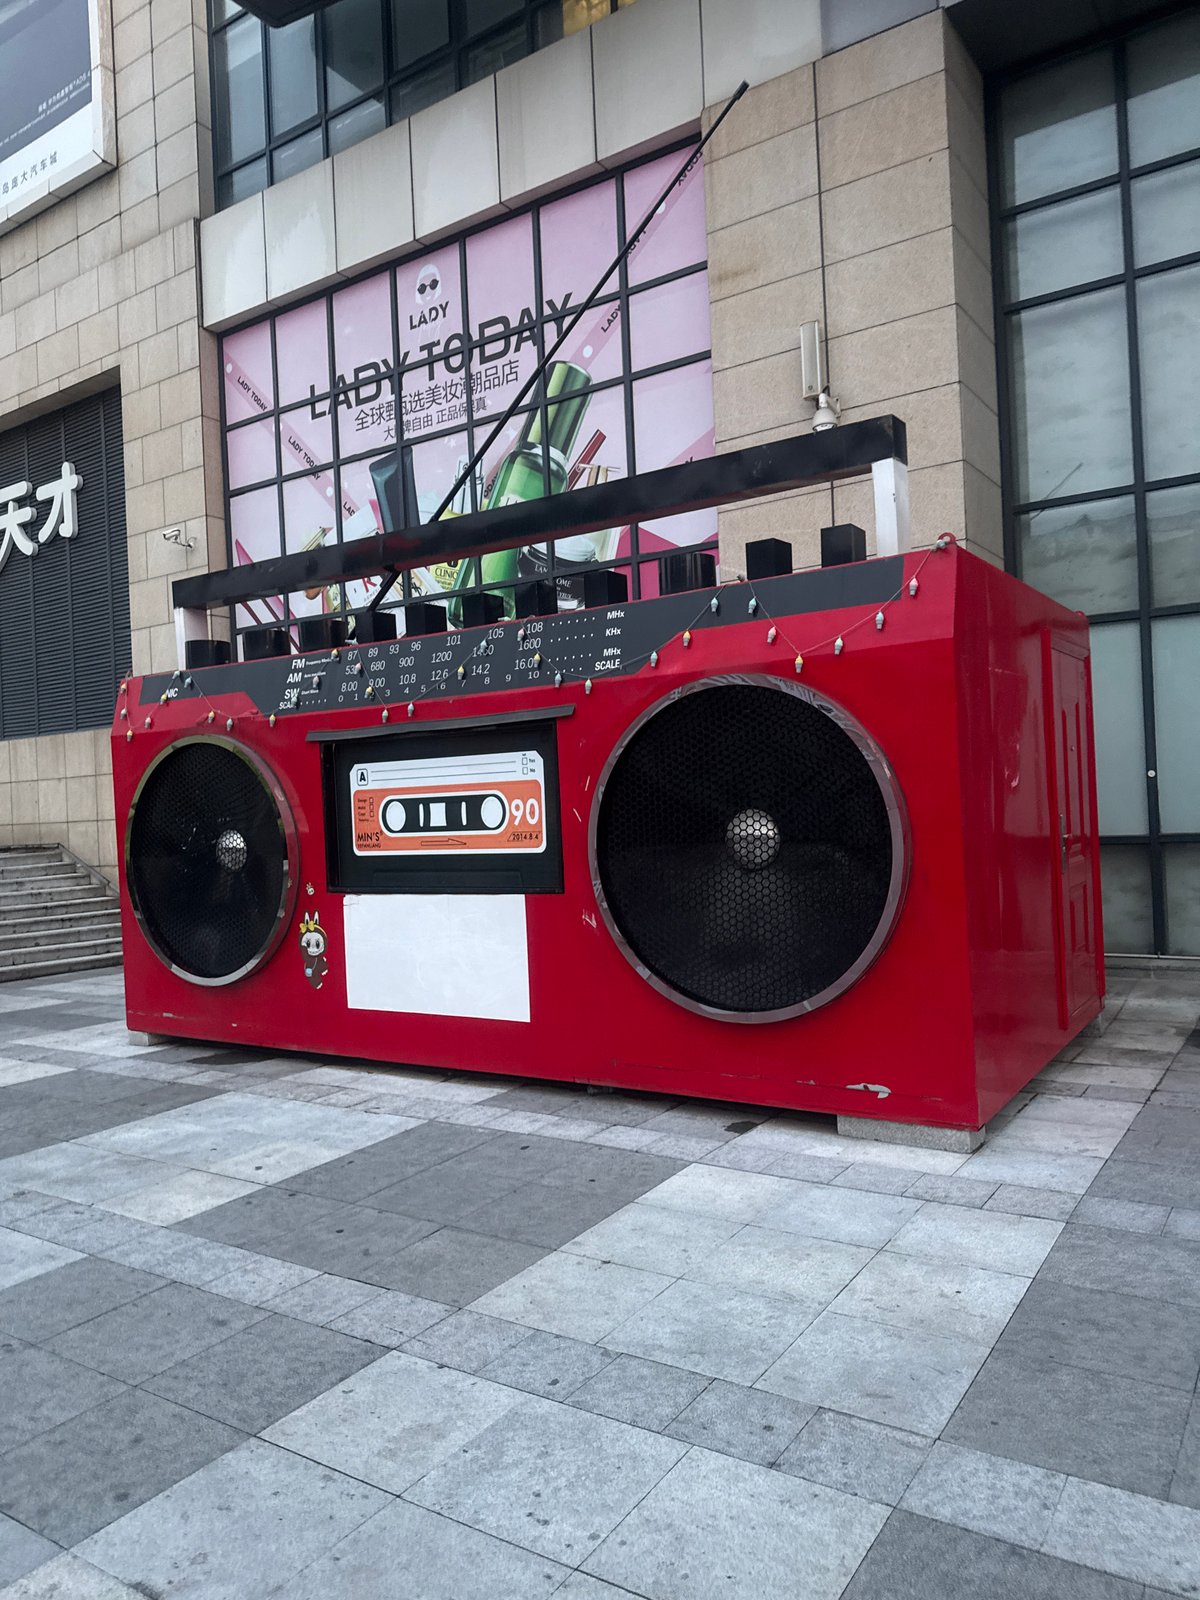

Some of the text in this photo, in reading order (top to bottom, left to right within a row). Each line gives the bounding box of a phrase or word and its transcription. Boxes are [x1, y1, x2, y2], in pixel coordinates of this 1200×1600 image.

[409, 302, 450, 330] LADY
[310, 292, 573, 421] LADY TODAY
[237, 376, 268, 412] LADY TODAY
[288, 435, 303, 454] LADY
[534, 564, 572, 588] LANOME
[286, 672, 302, 684] AM
[345, 664, 357, 675] 53
[370, 660, 386, 672] 680
[399, 656, 414, 668] 900
[431, 650, 452, 663] 1200
[518, 638, 542, 650] 1600
[606, 627, 622, 636] KHx
[292, 658, 306, 670] FM
[348, 650, 358, 661] 87
[368, 648, 378, 658] 89
[389, 644, 400, 654] 93
[410, 641, 422, 652] 96
[446, 635, 461, 646] 101
[488, 628, 504, 640] 105
[526, 622, 544, 634] 108
[607, 610, 625, 620] MHx
[284, 688, 300, 700] SW
[341, 681, 358, 692] 8.00
[400, 674, 416, 684] 10.8
[430, 668, 448, 681] 12.6
[472, 664, 490, 676] 14.2
[603, 648, 622, 657] MHx
[338, 694, 344, 702] 0
[420, 684, 426, 692] 5
[440, 682, 446, 690] 6
[461, 680, 466, 688] 7
[484, 676, 490, 684] 8
[505, 674, 512, 682] 9
[528, 670, 540, 679] 10
[594, 659, 620, 671] SCALE
[358, 772, 366, 782] A
[510, 798, 539, 826] 90
[358, 832, 380, 842] MIN'S
